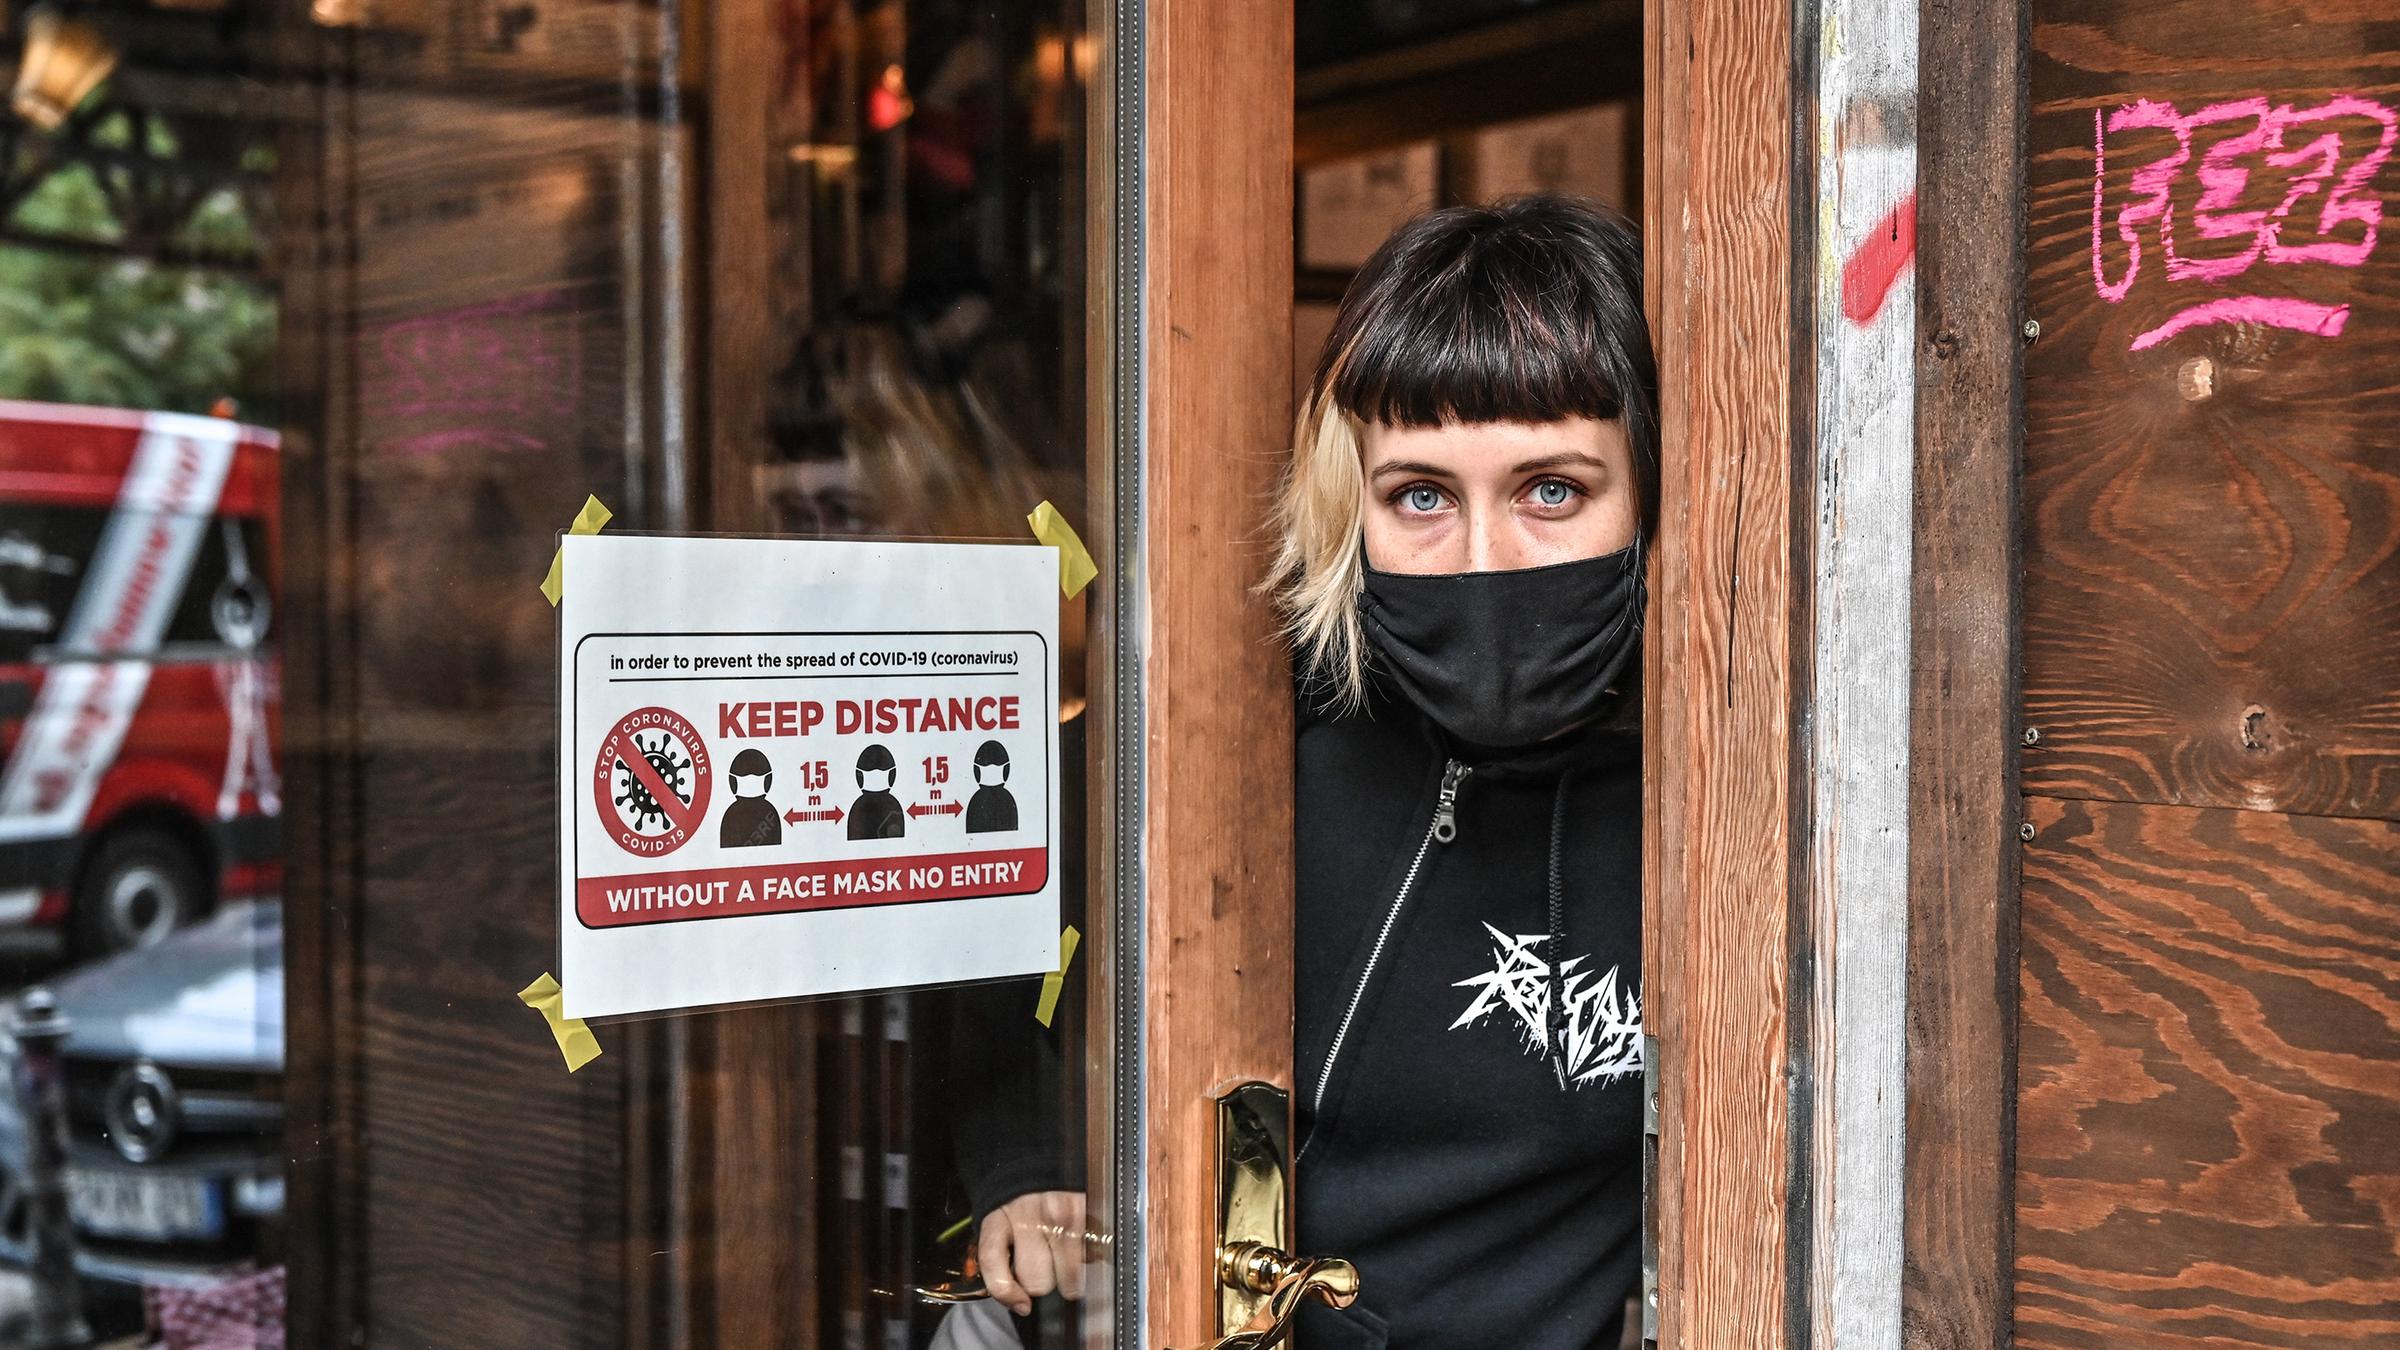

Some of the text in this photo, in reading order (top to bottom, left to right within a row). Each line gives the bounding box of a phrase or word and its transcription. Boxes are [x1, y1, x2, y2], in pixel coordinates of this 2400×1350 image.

[610, 650, 1019, 671] in order to prevent the spread of COVID-19 (coronavirus)
[719, 696, 1020, 739] KEEP DISTANCE
[599, 713, 707, 780] STOP CORONAVIRUS
[800, 760, 829, 791] 1,5
[922, 756, 949, 786] 1,5
[808, 795, 821, 806] m
[930, 789, 942, 800] m
[622, 829, 685, 852] COVID-19
[606, 861, 1024, 913] WITHOUT A FACE MASK NO ENTRY
